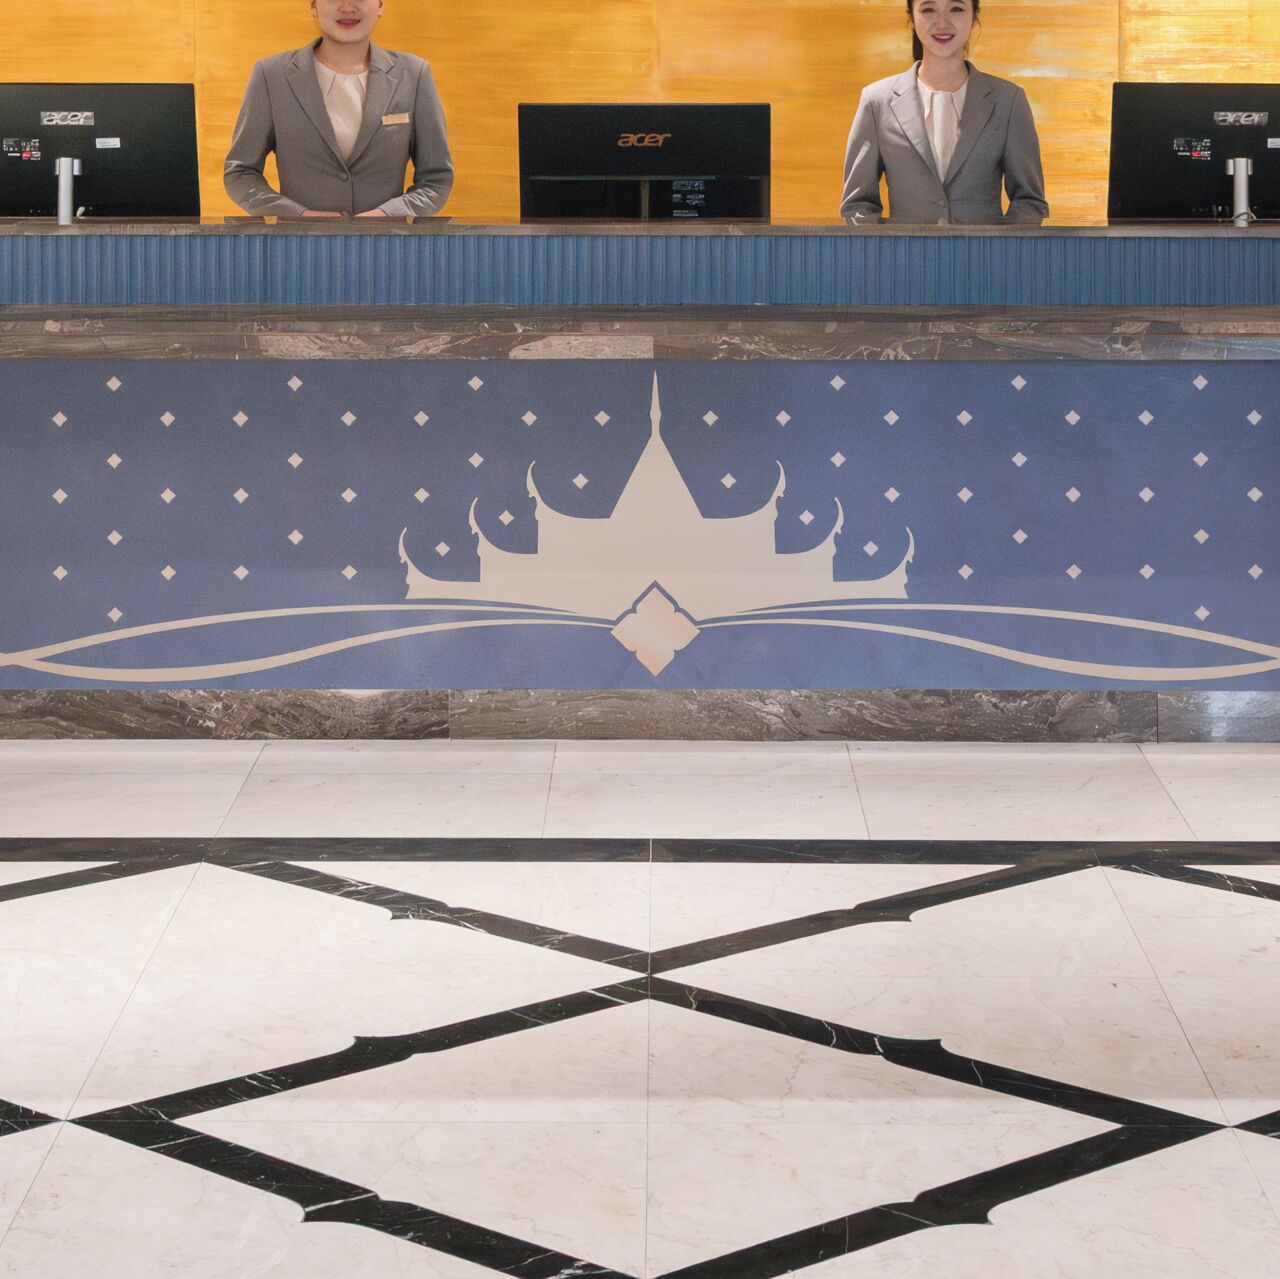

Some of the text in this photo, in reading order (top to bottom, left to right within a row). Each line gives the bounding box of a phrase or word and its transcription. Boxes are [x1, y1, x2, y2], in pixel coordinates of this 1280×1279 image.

[42, 111, 93, 125] acer
[1218, 112, 1265, 125] acer
[617, 133, 672, 147] acer
